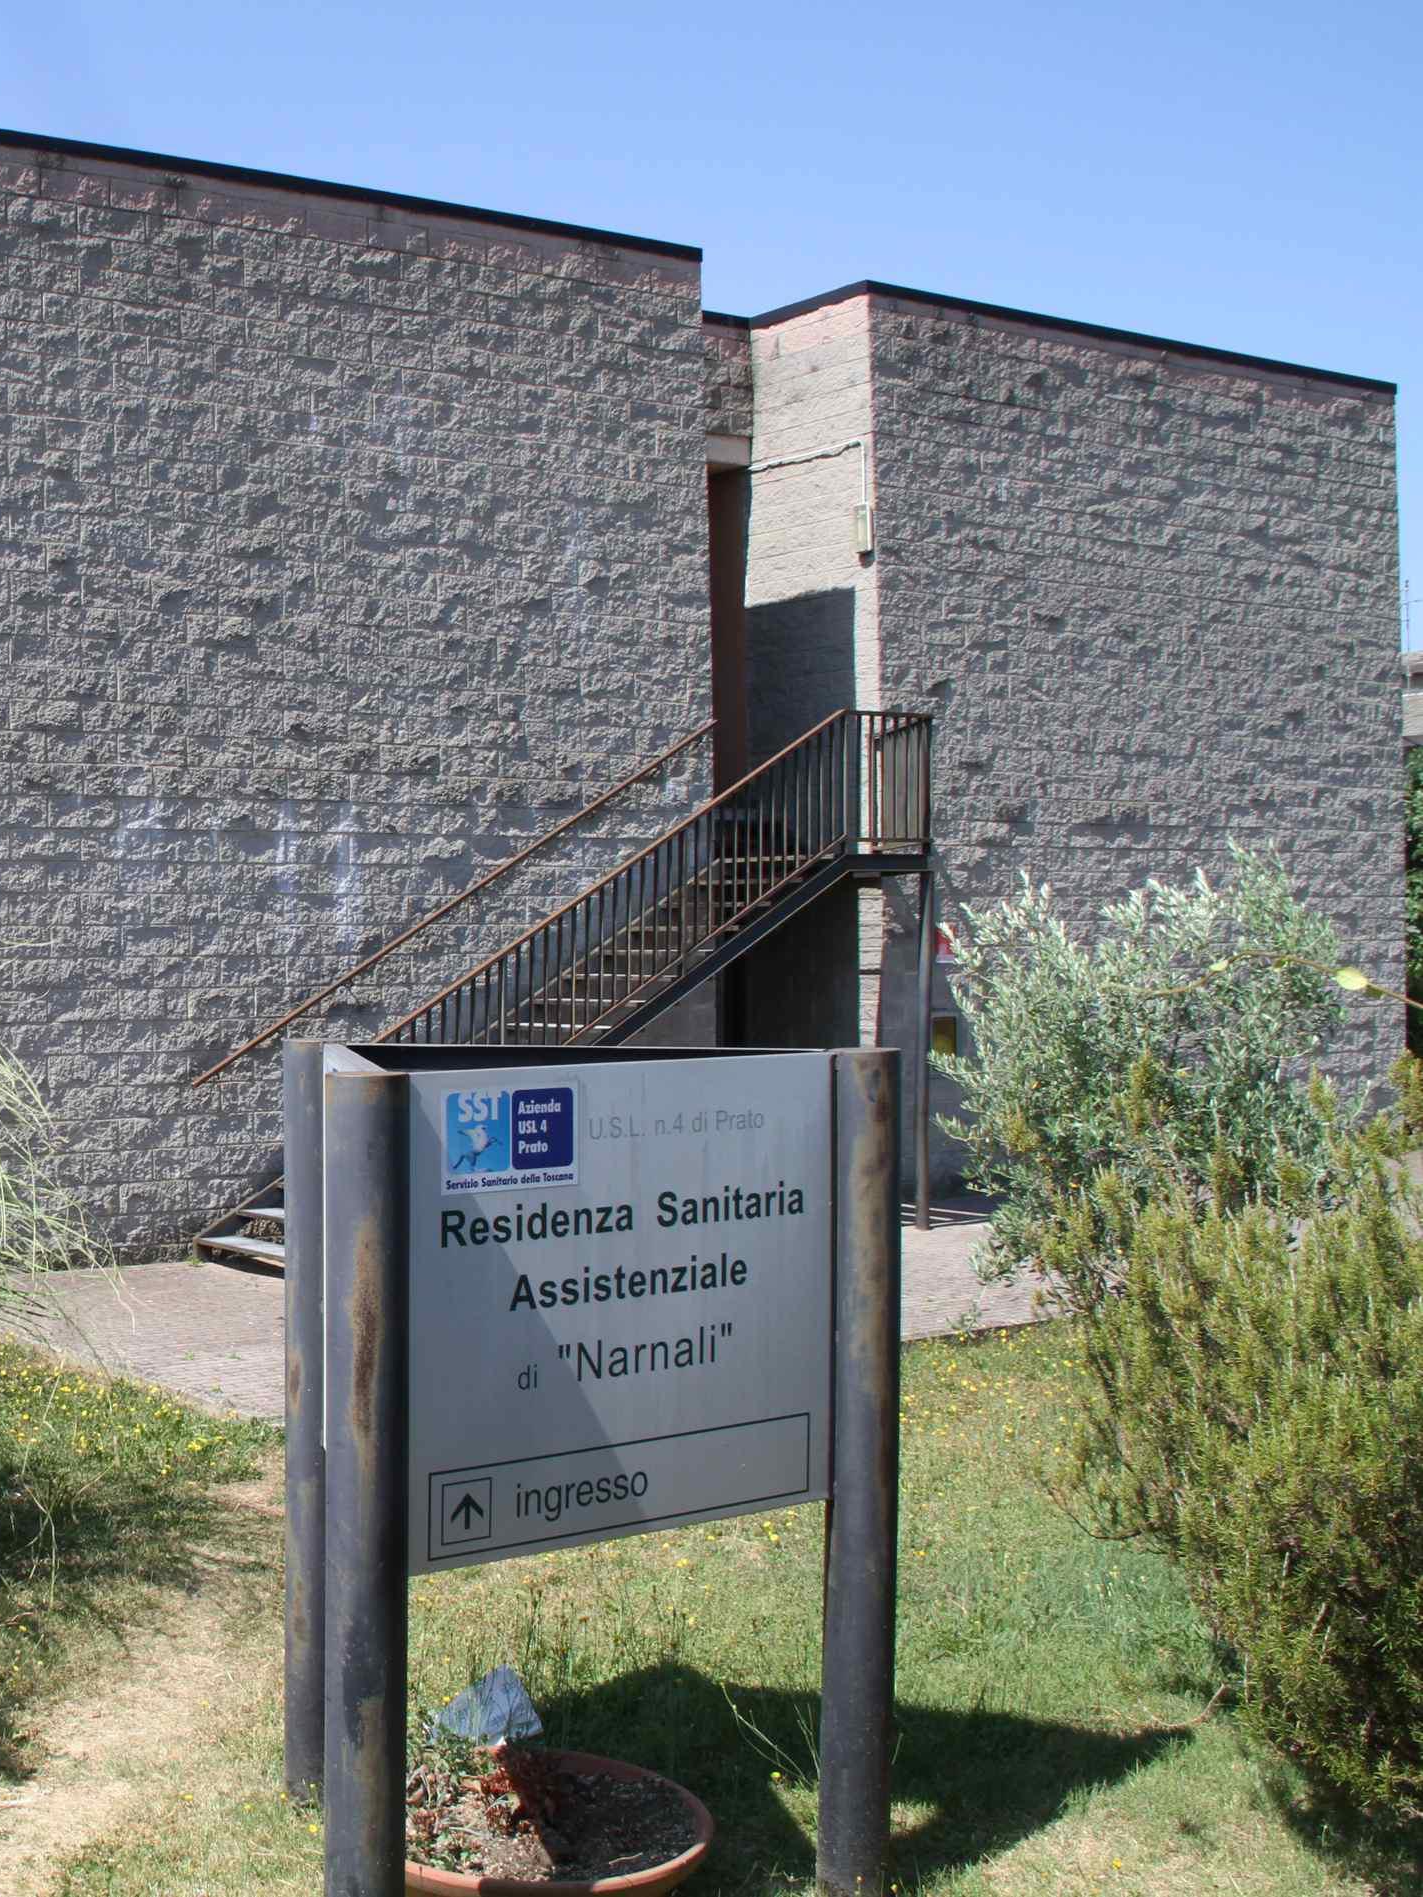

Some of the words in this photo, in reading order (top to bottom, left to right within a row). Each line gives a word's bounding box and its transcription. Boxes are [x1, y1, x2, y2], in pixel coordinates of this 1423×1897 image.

[457, 1089, 500, 1123] SST
[518, 1099, 562, 1115] Azienda
[518, 1121, 537, 1134] USL
[540, 1120, 547, 1134] 4
[588, 1114, 646, 1140] U.S.L.
[691, 1110, 708, 1134] di
[715, 1108, 765, 1131] Prato
[518, 1140, 549, 1154] Prato
[446, 1178, 479, 1190] Servizio
[481, 1174, 518, 1188] Sanitario
[520, 1174, 541, 1184] della
[543, 1171, 574, 1182] Toscana
[440, 1203, 634, 1248] Residenza
[657, 1180, 805, 1228] Sanitaria
[509, 1253, 748, 1312] Assistenziale
[517, 1364, 538, 1390] di
[557, 1322, 733, 1382] "Narnali"
[515, 1470, 648, 1521] ingresso
